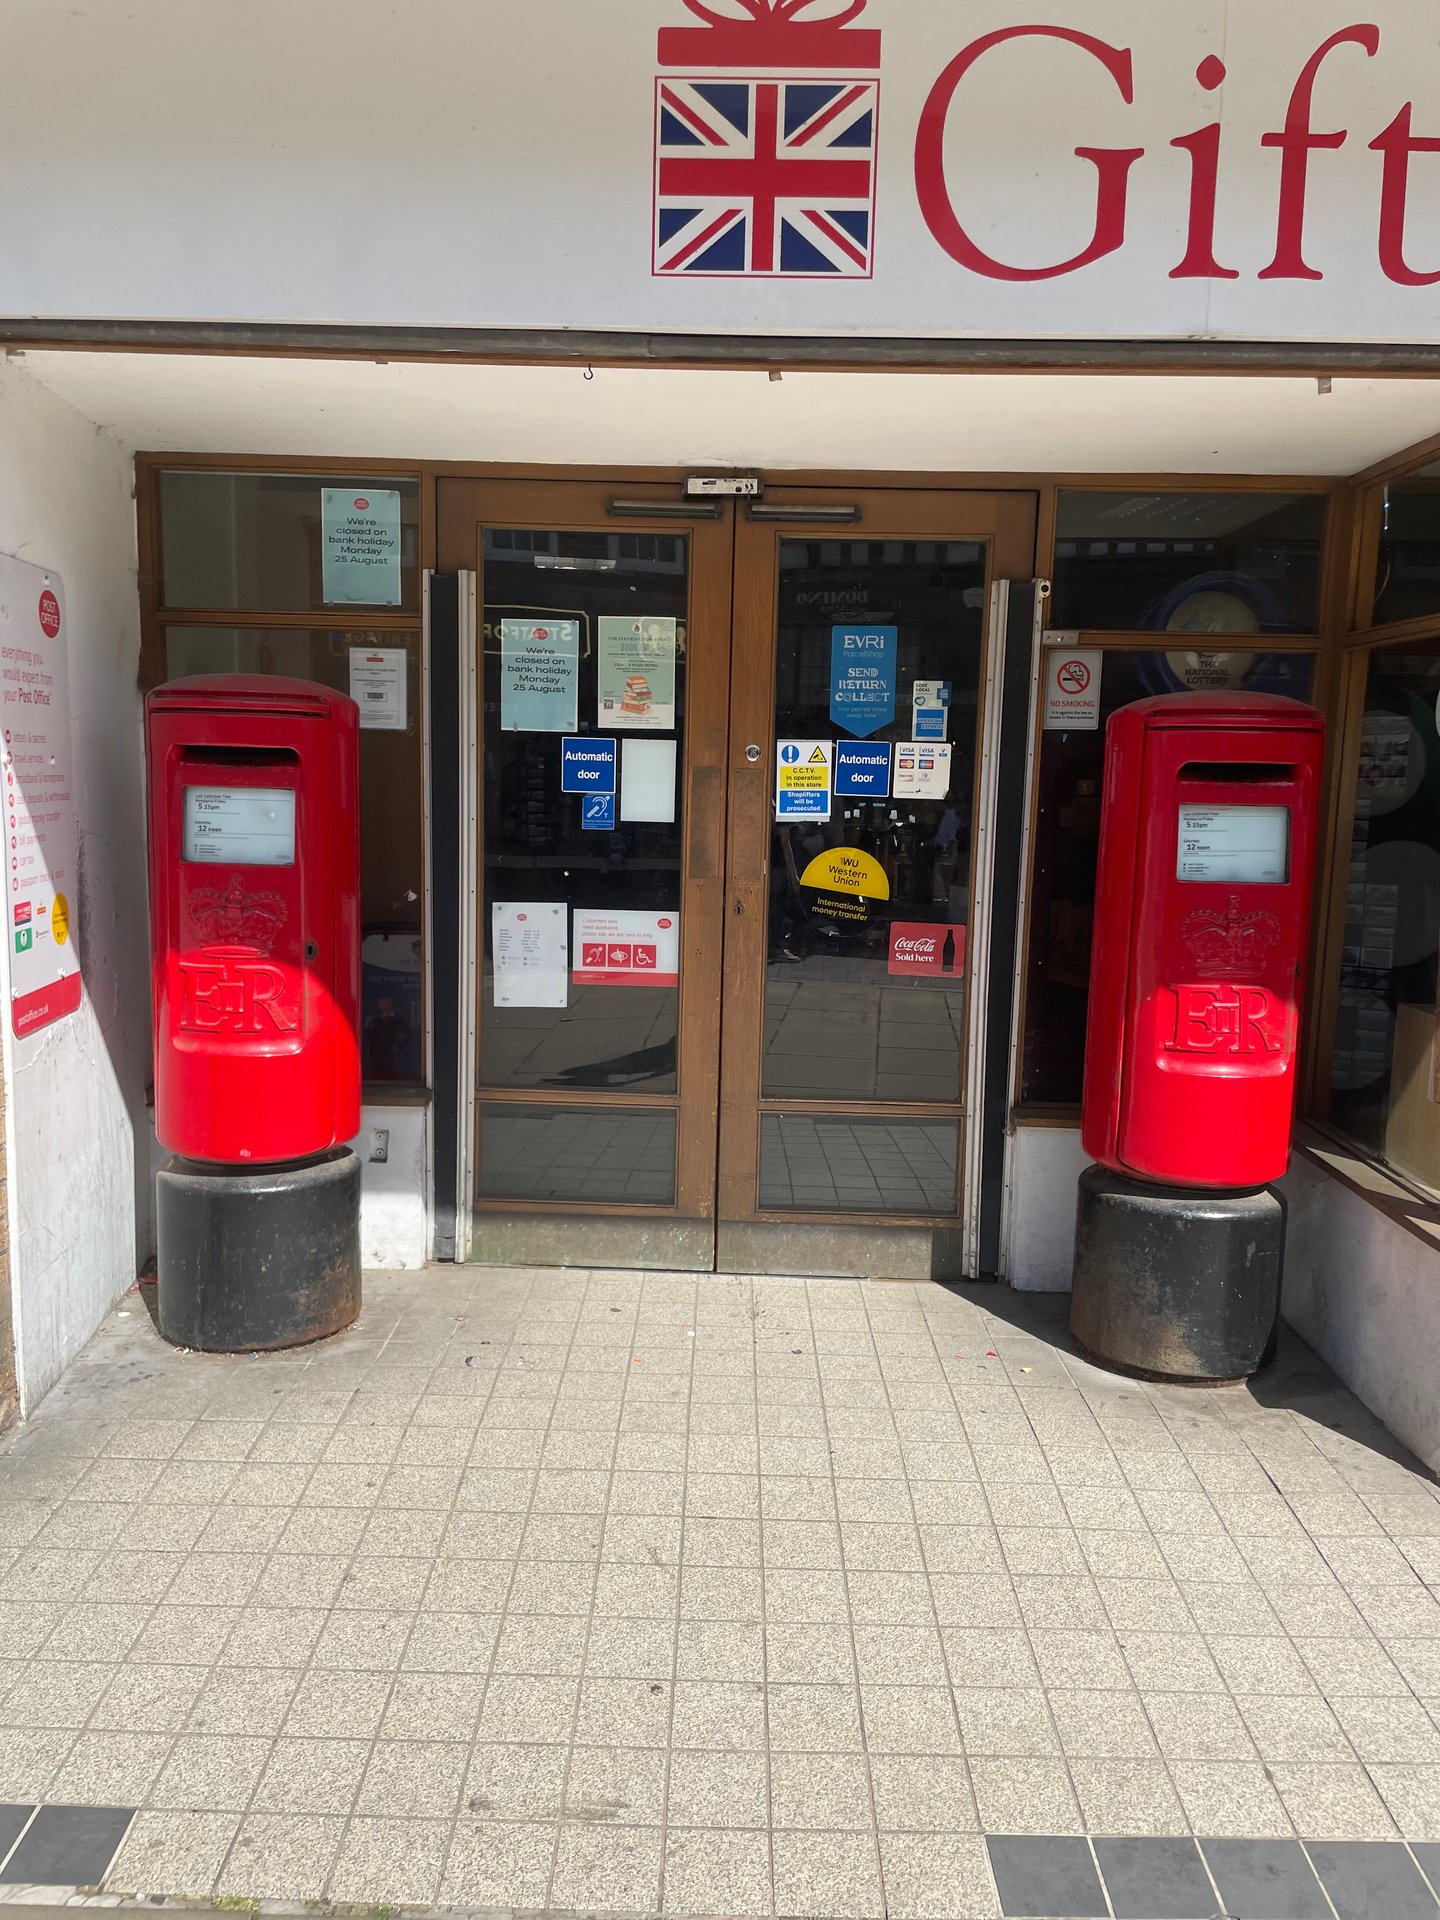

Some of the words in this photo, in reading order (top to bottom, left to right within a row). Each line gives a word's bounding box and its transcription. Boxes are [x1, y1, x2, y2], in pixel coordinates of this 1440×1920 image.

[915, 24, 1440, 287] Gift
[346, 517, 377, 526] We're
[336, 527, 371, 535] closed
[328, 536, 355, 544] bank
[357, 537, 395, 548] holiday
[340, 546, 382, 556] Monday
[335, 555, 348, 563] 25
[350, 556, 389, 566] August
[43, 599, 56, 613] POST
[41, 612, 58, 627] OFFICE
[526, 647, 556, 656] We're
[844, 651, 884, 659] ParcelShop
[515, 656, 550, 665] closed
[507, 665, 533, 673] bank
[535, 666, 572, 676] holiday
[848, 667, 879, 677] SEND
[519, 674, 561, 684] Monday
[513, 684, 526, 692] 25
[528, 684, 566, 694] August
[839, 680, 888, 689] RETURN
[19, 687, 32, 703] Post
[34, 689, 50, 705] Office
[835, 692, 890, 702] COLLECT
[565, 751, 613, 762] Automatic
[839, 754, 888, 765] Automatic
[577, 769, 600, 779] door
[851, 773, 875, 783] door
[787, 791, 820, 799] Shoplifters
[842, 857, 859, 868] WU
[829, 865, 868, 880] Western
[833, 875, 860, 888] Union
[817, 897, 866, 913] International
[812, 905, 837, 918] money
[838, 910, 869, 921] transfer
[894, 937, 937, 952] Coca-Cola
[895, 953, 914, 961] Sold
[915, 953, 934, 962] here
